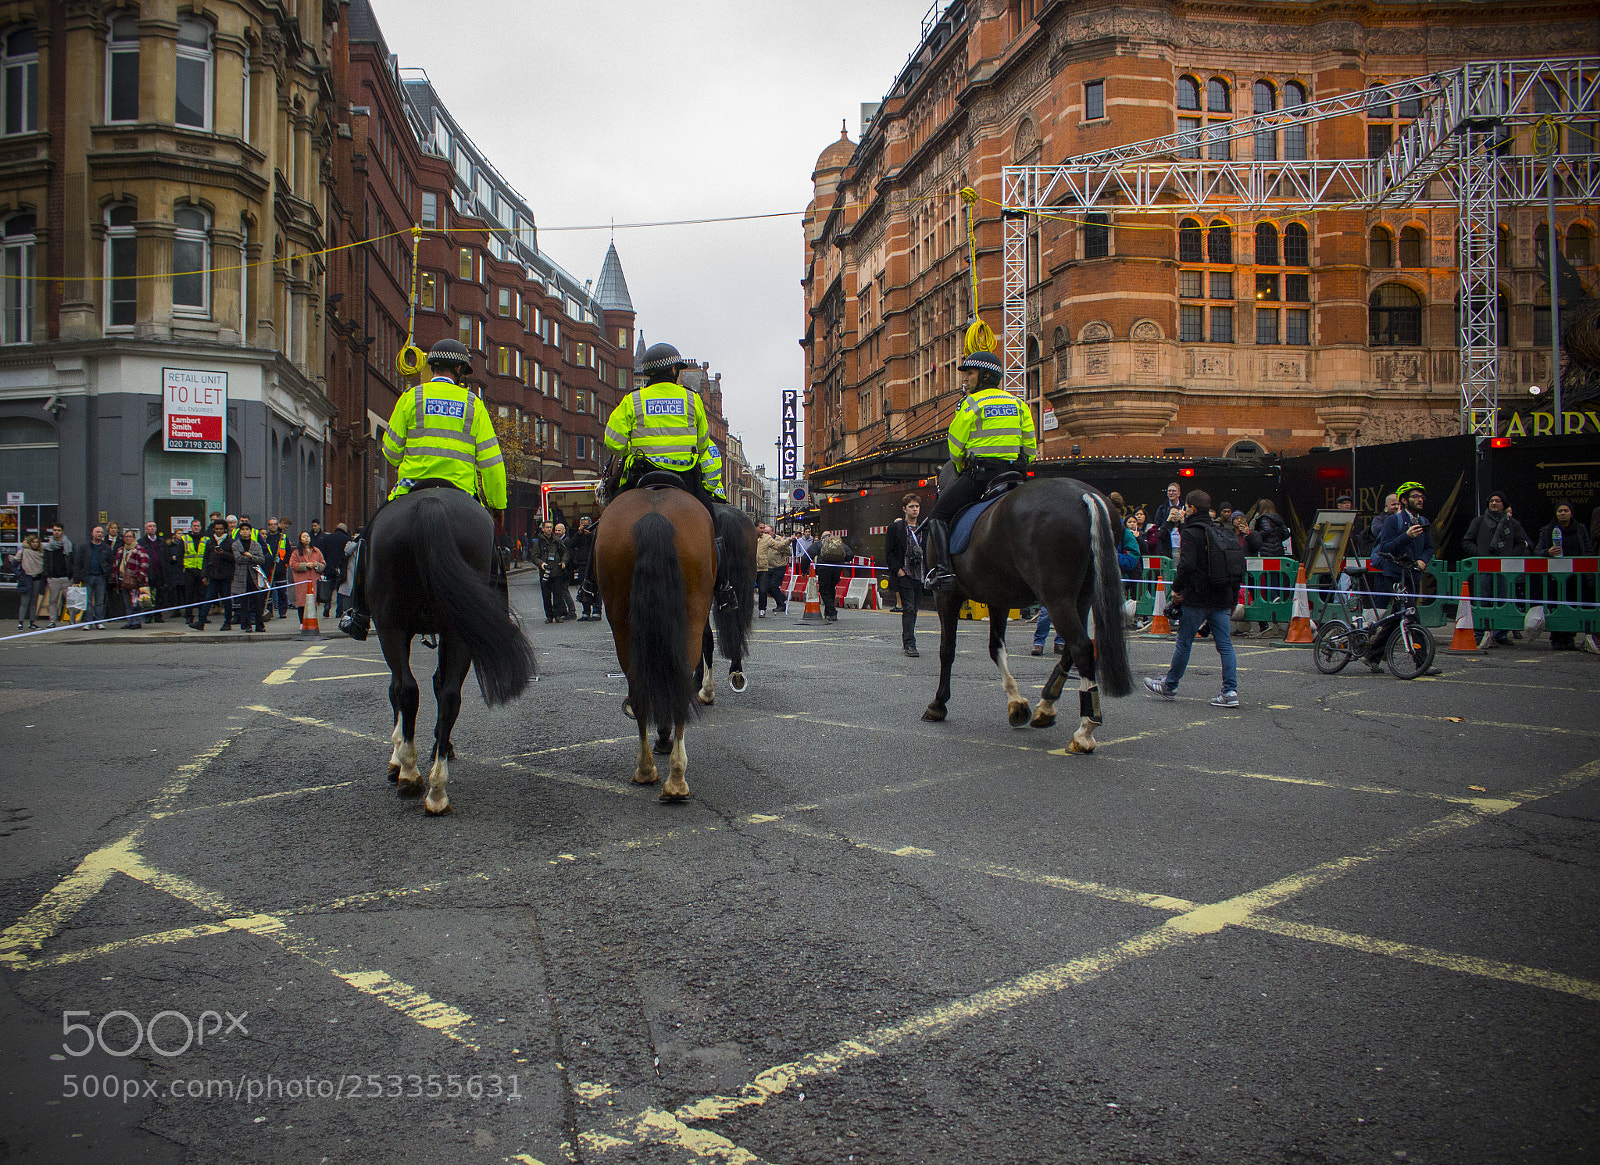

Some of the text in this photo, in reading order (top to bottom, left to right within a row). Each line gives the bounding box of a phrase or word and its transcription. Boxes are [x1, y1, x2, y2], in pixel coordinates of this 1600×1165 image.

[168, 372, 221, 384] RETAIL UNIT
[168, 386, 223, 404] TO LET
[427, 404, 462, 416] POLICE
[648, 404, 682, 413] POLICE
[985, 408, 1018, 418] POLICE
[171, 416, 201, 424] Lambert
[171, 430, 203, 439] Hampton
[784, 391, 795, 477] PALACE
[169, 440, 183, 448] 020
[203, 441, 221, 449] 2030
[1552, 473, 1589, 481] THEATRE
[1538, 481, 1582, 490] ENTRANCE
[1546, 489, 1594, 497] BOX OFFICE
